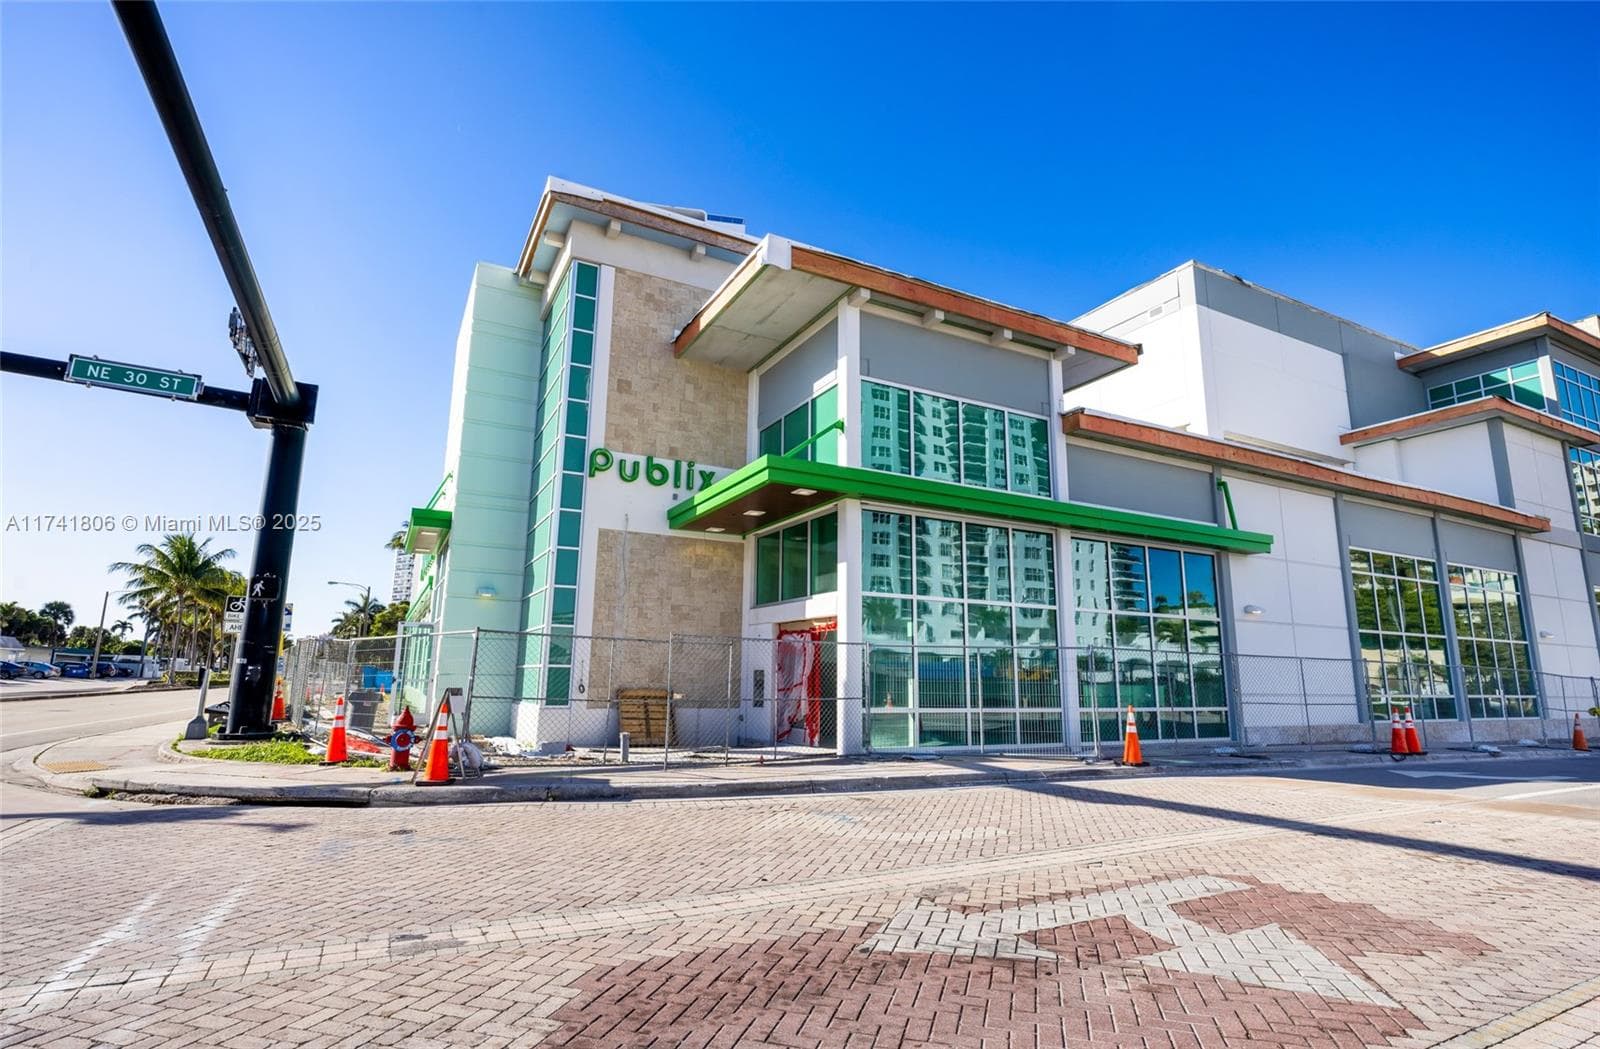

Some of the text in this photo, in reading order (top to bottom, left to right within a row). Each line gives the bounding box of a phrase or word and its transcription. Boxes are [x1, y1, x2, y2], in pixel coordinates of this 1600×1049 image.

[87, 364, 182, 390] NE 30 ST
[588, 447, 716, 491] Publix
